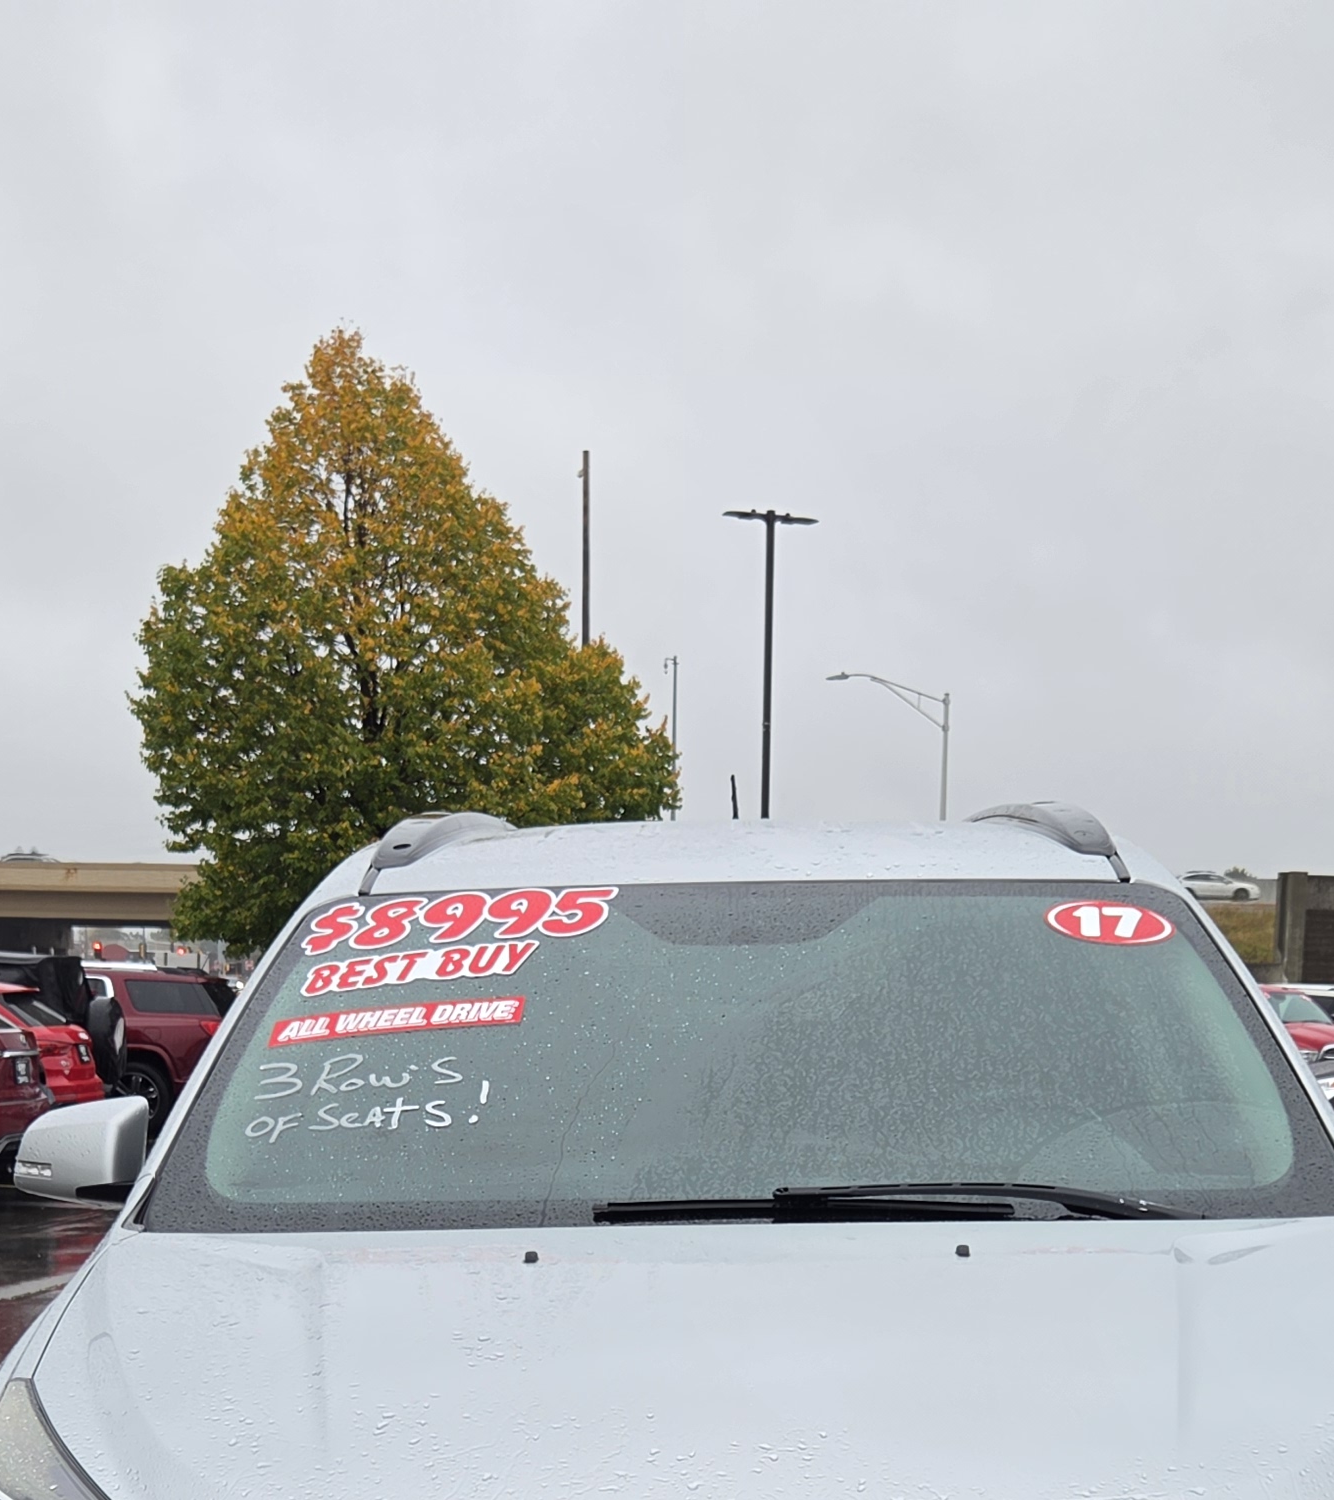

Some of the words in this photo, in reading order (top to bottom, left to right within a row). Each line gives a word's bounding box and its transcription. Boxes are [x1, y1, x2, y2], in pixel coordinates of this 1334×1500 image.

[301, 886, 619, 956] $8995
[1072, 906, 1143, 938] 17
[303, 950, 429, 995] BEST
[434, 941, 536, 978] BUY
[277, 1021, 329, 1043] ALL
[335, 1006, 427, 1034] WHEEL
[430, 999, 520, 1024] DRIVE
[254, 1062, 303, 1100] 3
